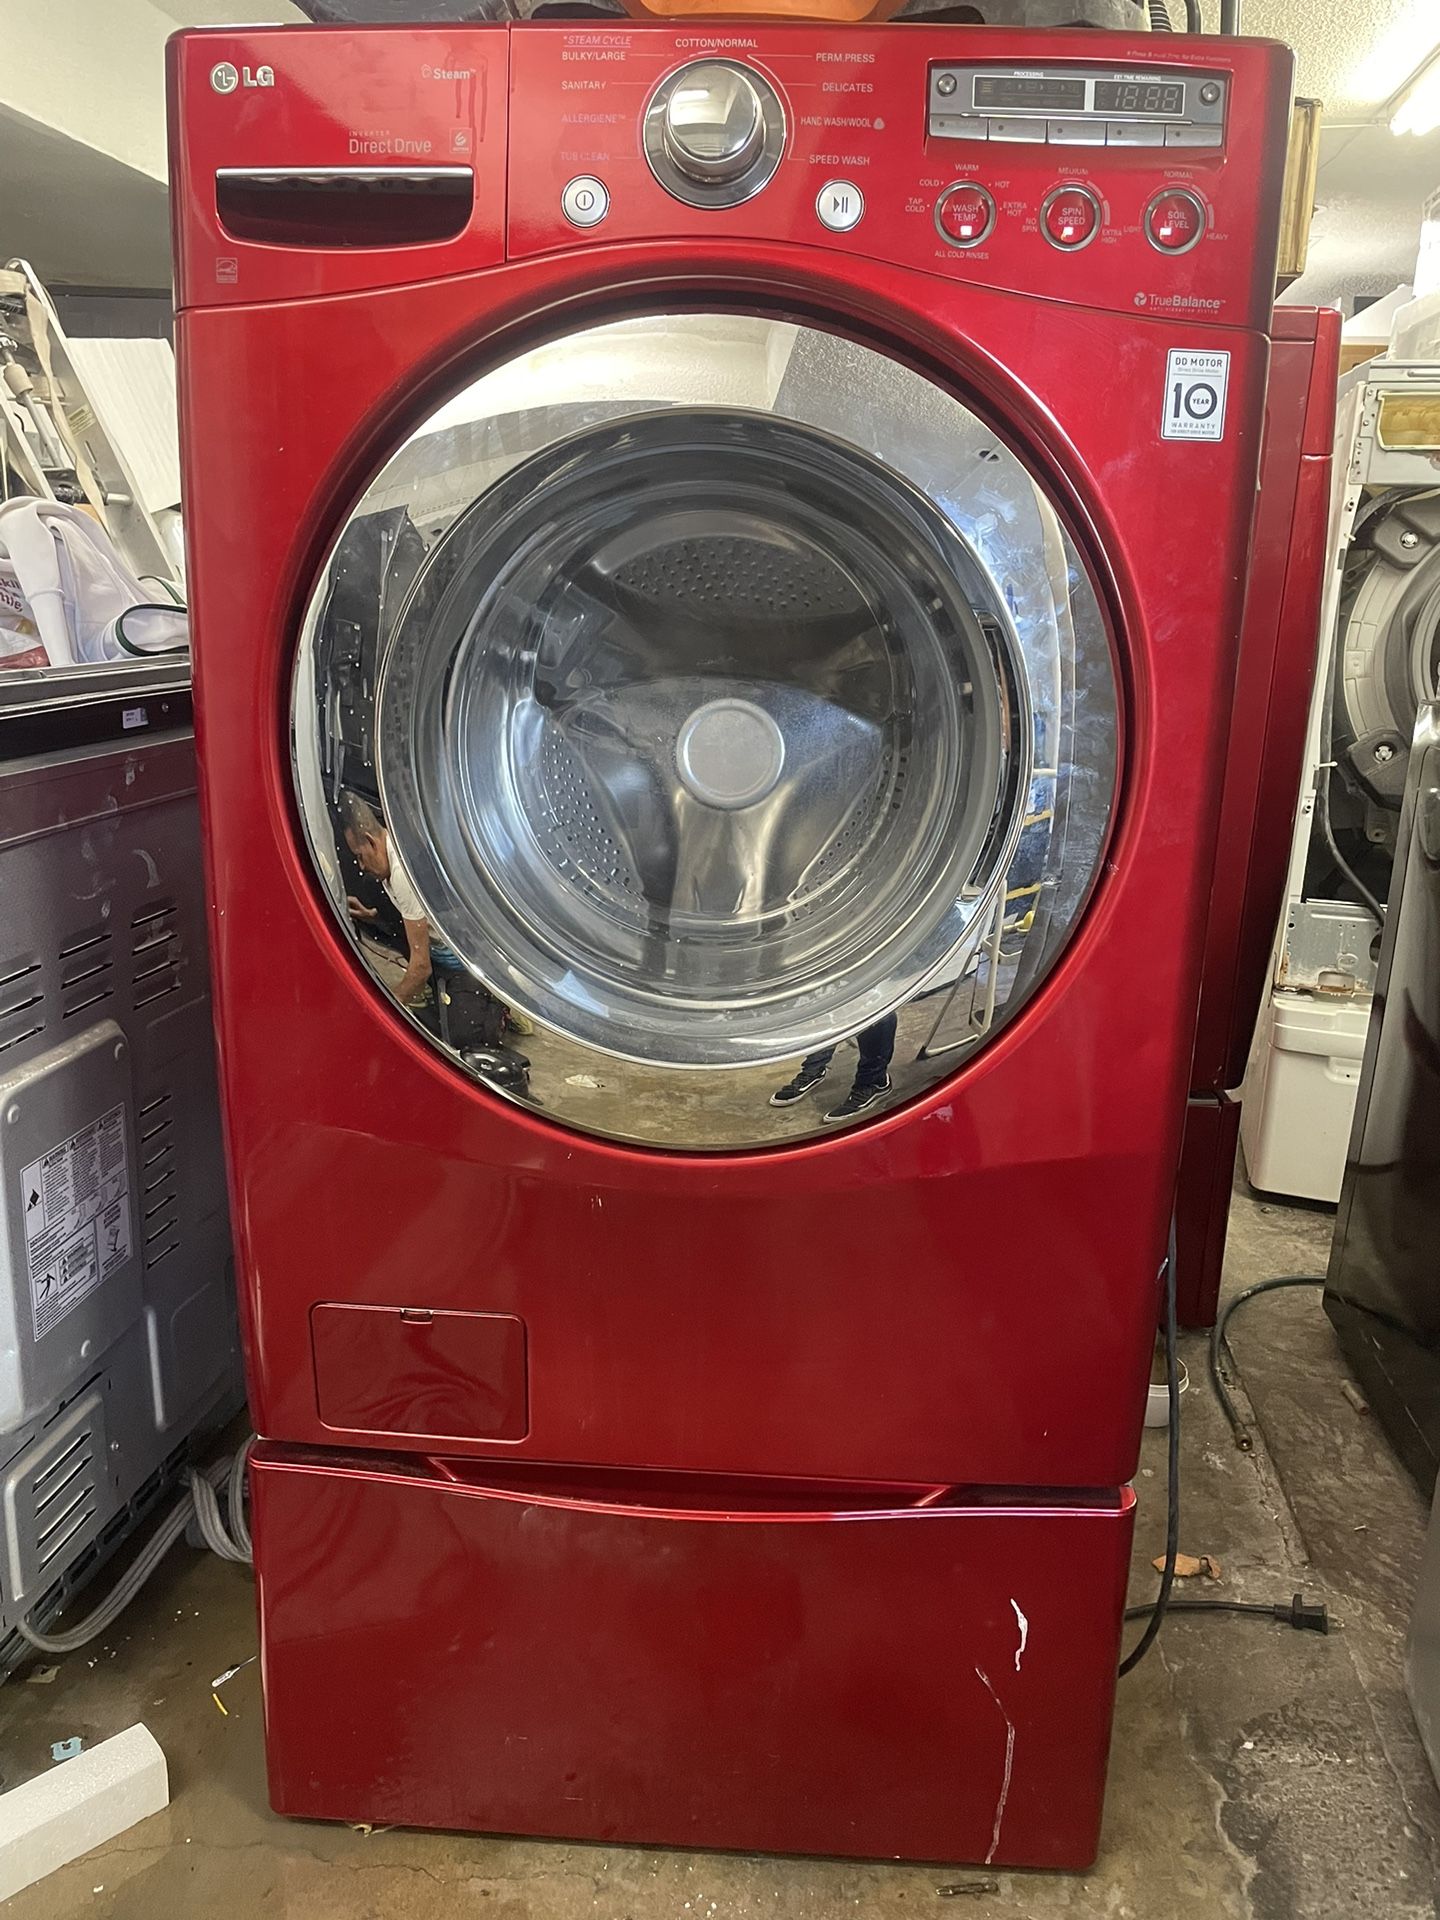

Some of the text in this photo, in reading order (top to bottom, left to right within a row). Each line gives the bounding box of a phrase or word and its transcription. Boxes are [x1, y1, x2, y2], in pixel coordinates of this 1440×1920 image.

[601, 35, 632, 45] CYCLE
[675, 38, 758, 48] COTTON/NORMAL
[562, 51, 626, 61] BULKY/LARGE
[243, 65, 275, 87] LG
[561, 80, 607, 90] SANITARY
[822, 82, 873, 93] DELICATES
[824, 116, 872, 128] WASH/WOOL
[349, 138, 432, 154] Direct Drive
[809, 154, 871, 166] SPEED WASH
[1058, 167, 1088, 175] MEDIUM
[1163, 170, 1193, 179] NORMAL
[919, 179, 939, 187] COLD
[905, 205, 925, 213] COLD
[952, 204, 979, 213] WASH
[1003, 201, 1027, 209] EXTRA
[1062, 207, 1082, 216] SPIN
[1167, 211, 1186, 219] SOIL
[1025, 217, 1037, 225] NO
[1058, 216, 1086, 225] SPEED
[1164, 219, 1190, 229] LEVEL
[1022, 225, 1037, 233] SPIN
[935, 250, 945, 258] ALL
[966, 252, 989, 260] RINSES
[1175, 357, 1222, 367] DD MOTOR
[1173, 382, 1218, 420] 10
[1171, 422, 1216, 430] WARRANTY
